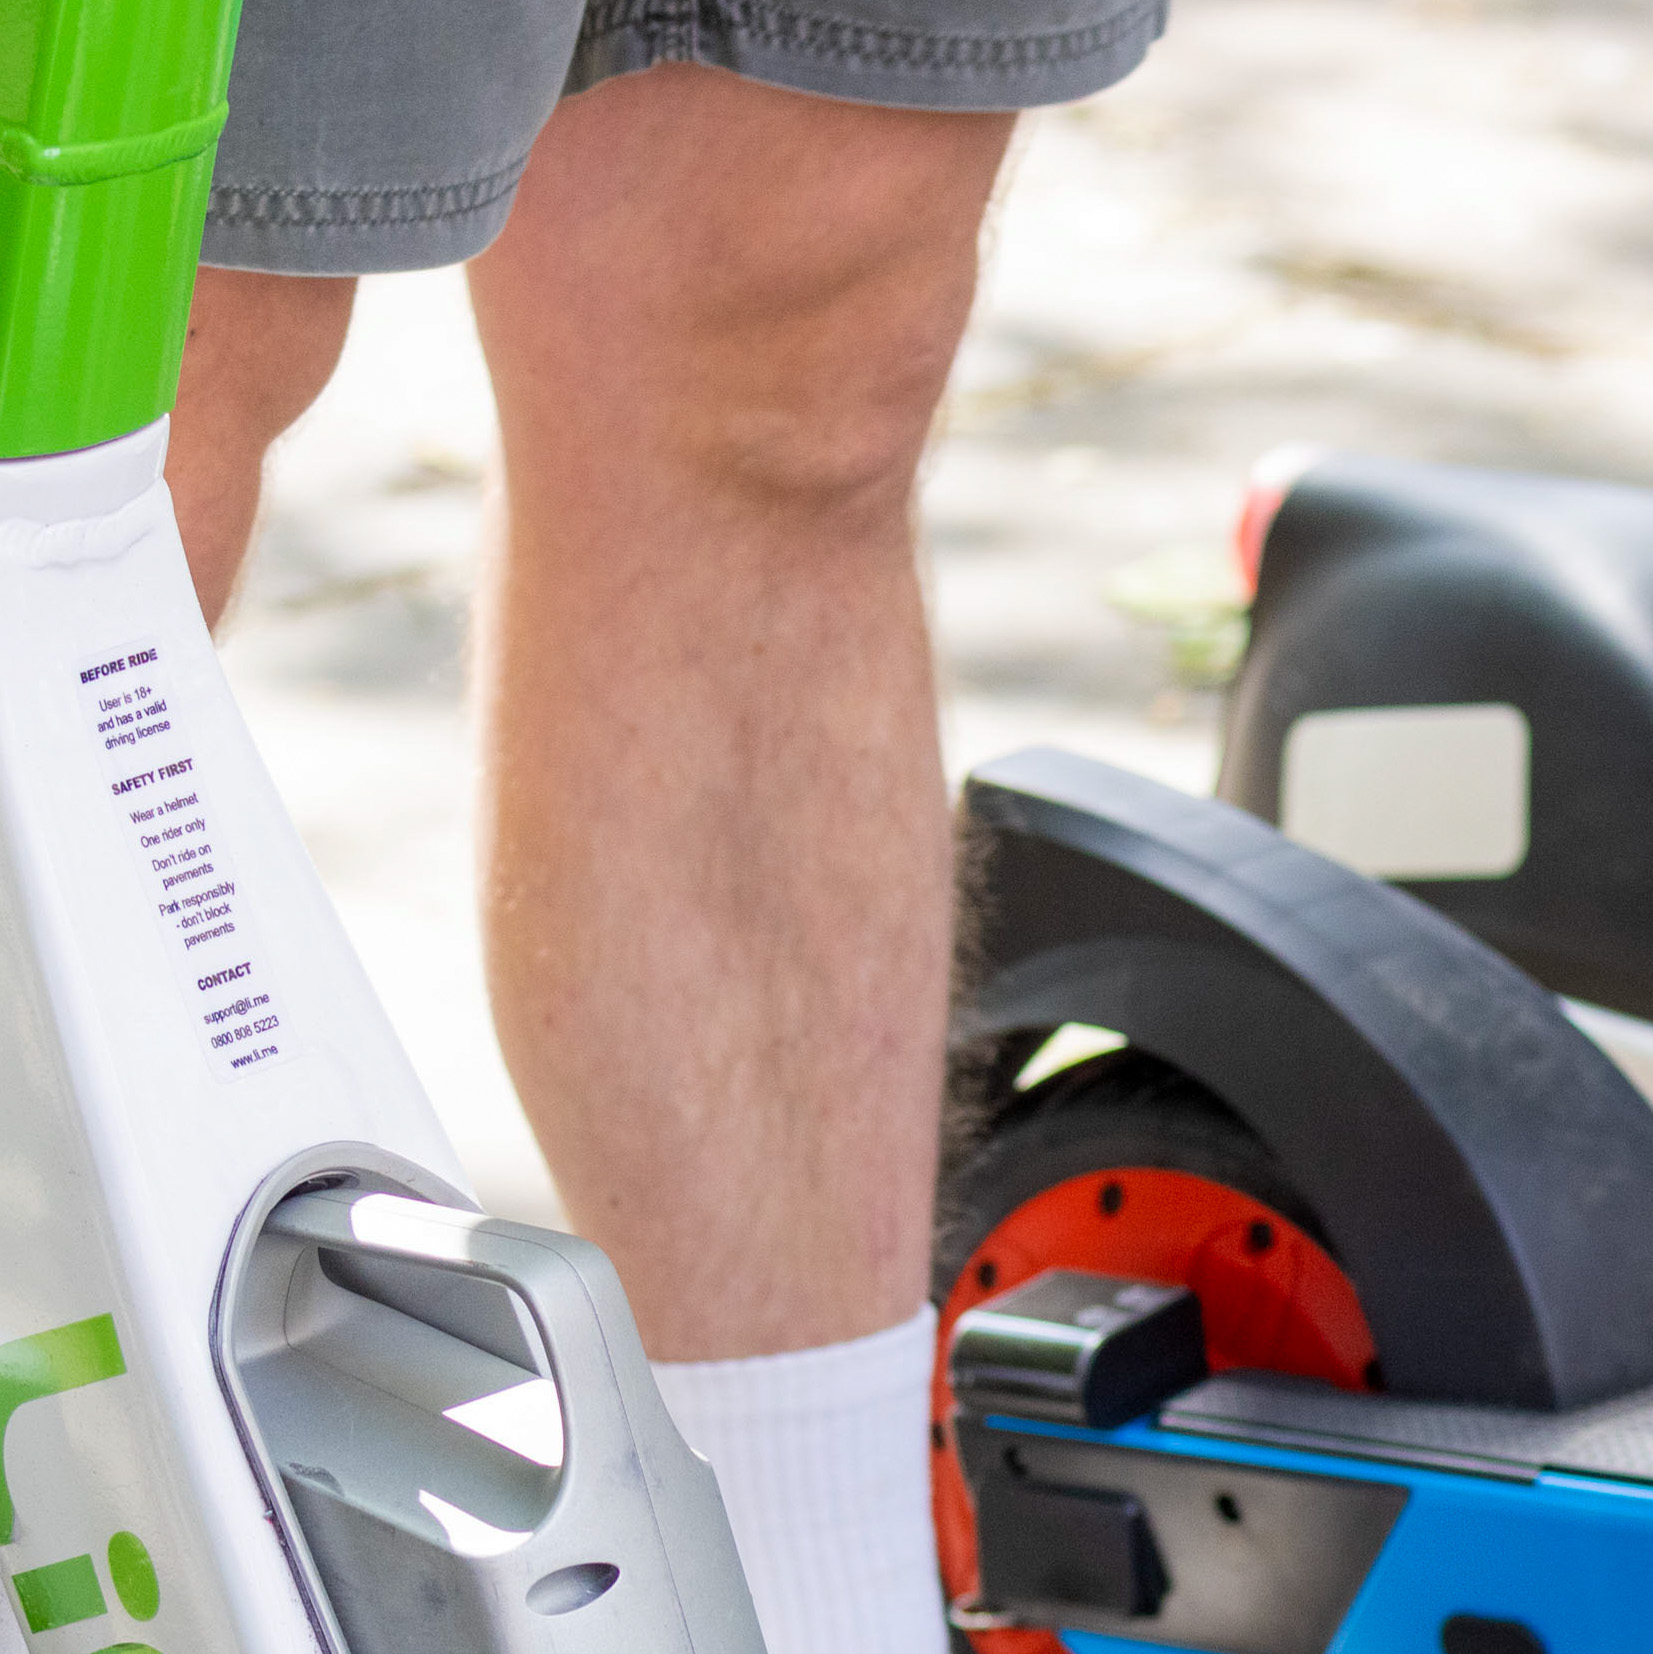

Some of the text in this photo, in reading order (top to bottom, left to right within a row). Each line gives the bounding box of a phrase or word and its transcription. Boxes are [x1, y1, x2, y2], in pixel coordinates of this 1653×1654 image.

[80, 648, 158, 684] BEFORE RIDE
[99, 686, 152, 712] User is 18+
[97, 699, 167, 733] and has a valid
[105, 720, 171, 750] driving license
[111, 758, 193, 795] SAFETY FIRST
[129, 792, 199, 824] Wear a helmet
[140, 818, 206, 848] One rider only
[152, 844, 212, 872] Don't ride on
[163, 862, 214, 891] pavements
[158, 881, 235, 916] Park responsibly
[181, 912, 204, 929] don't
[204, 902, 232, 921] block
[184, 922, 235, 951] pavements
[197, 962, 251, 991] CONTACT
[204, 994, 270, 1024] support@li.me
[211, 1015, 279, 1048] 0800 808 5223
[231, 1045, 279, 1069] www.li.me
